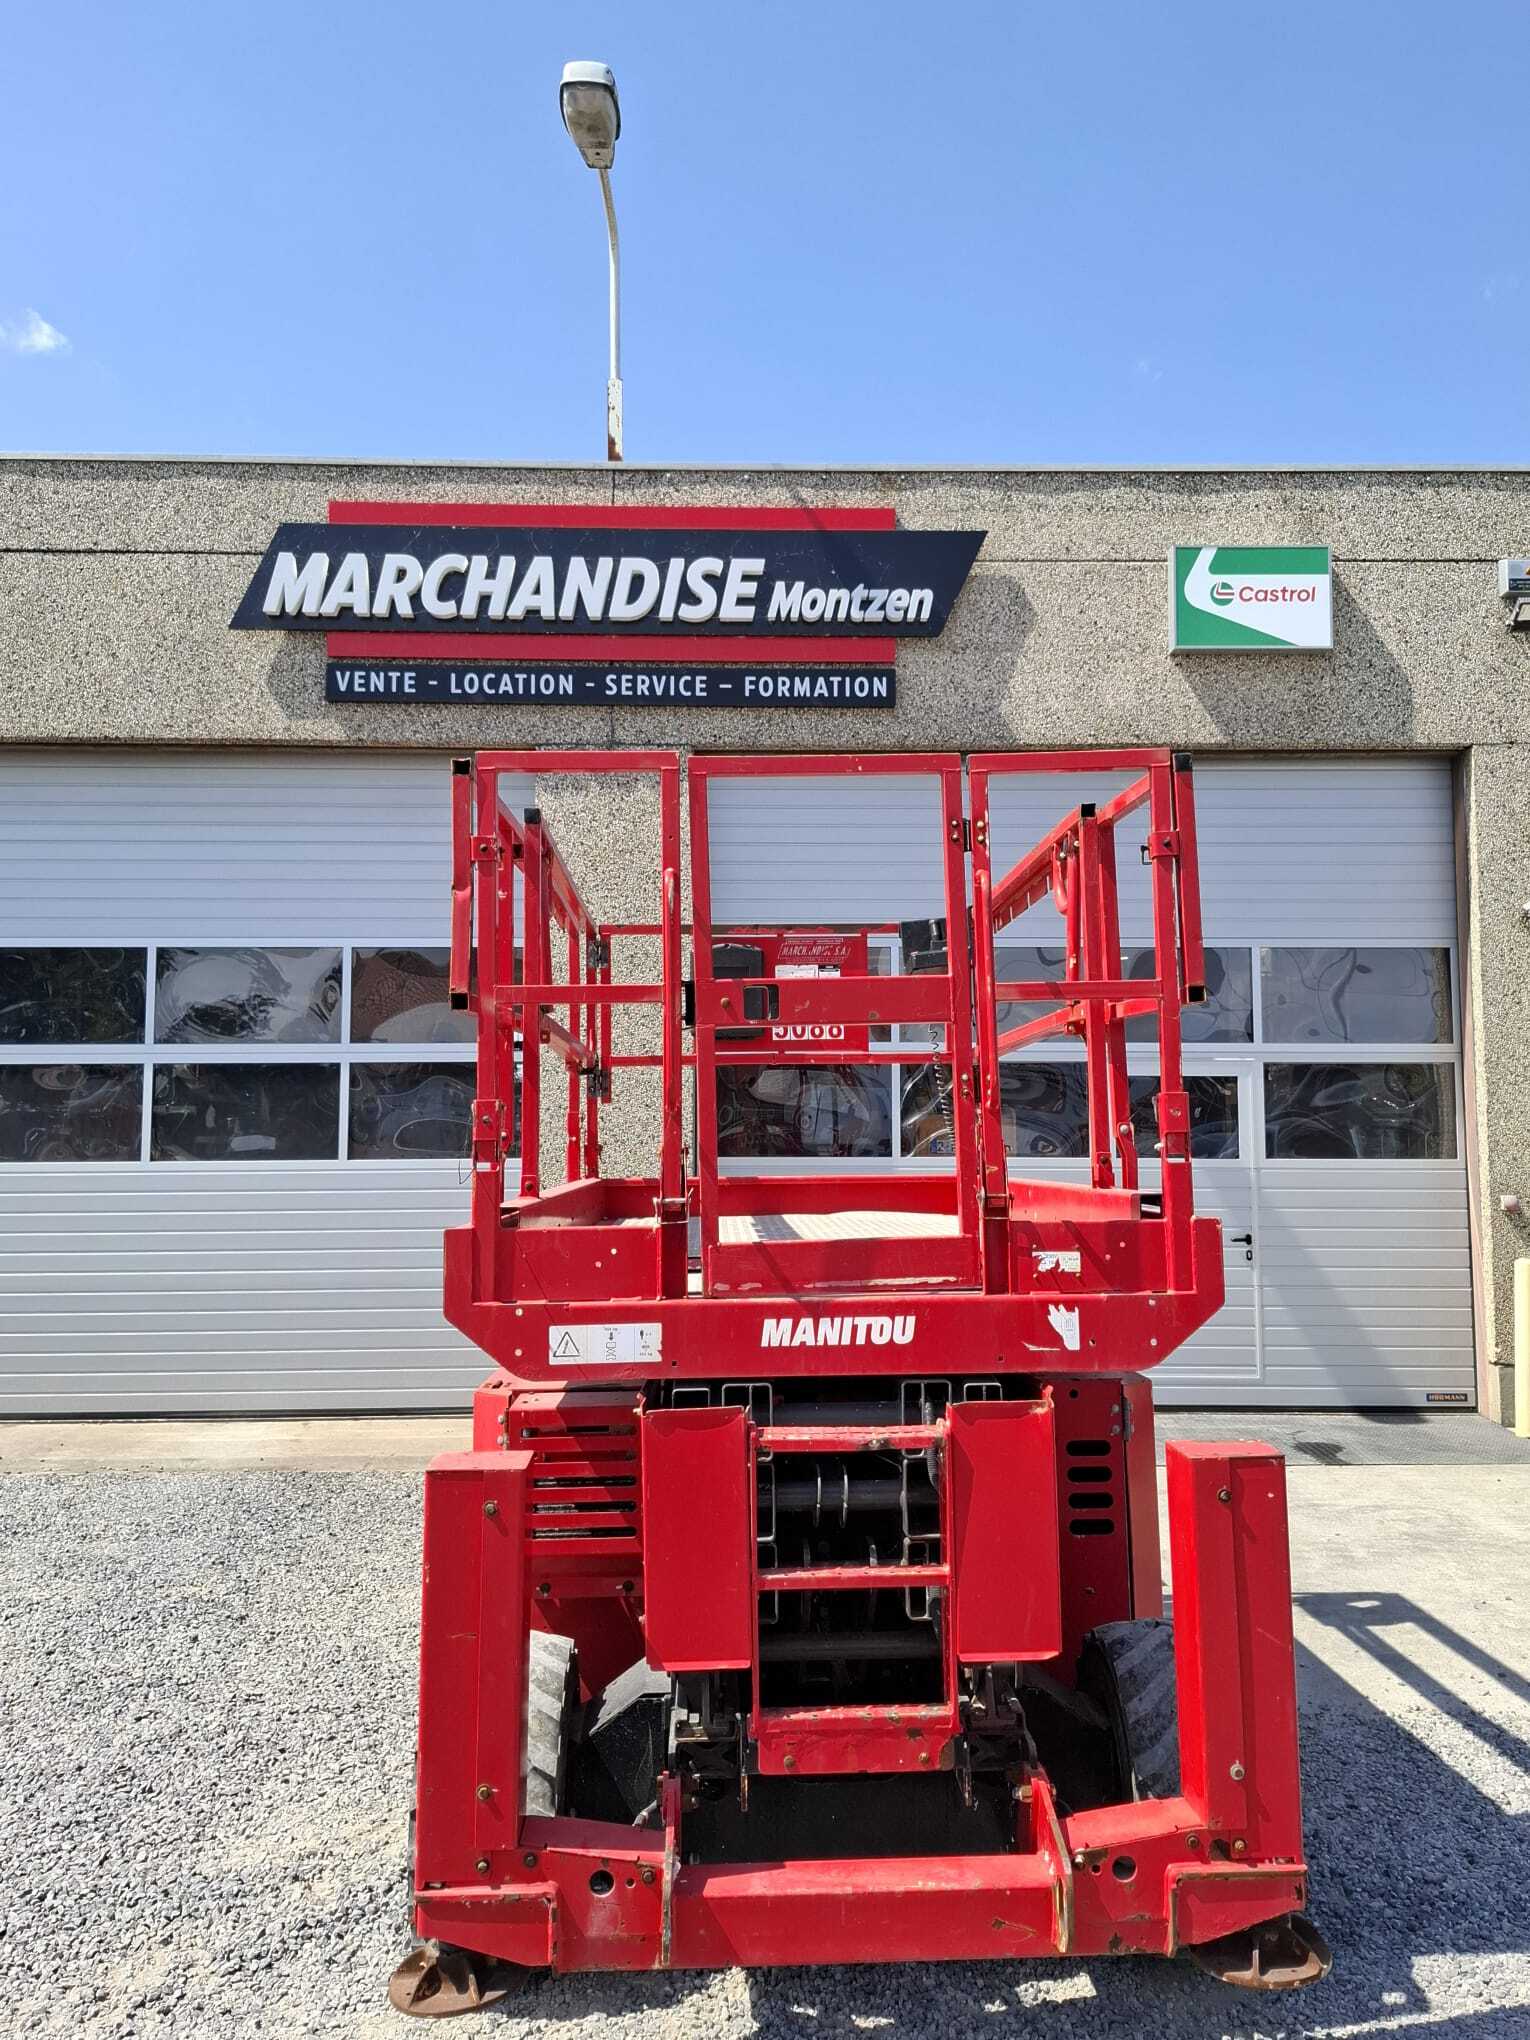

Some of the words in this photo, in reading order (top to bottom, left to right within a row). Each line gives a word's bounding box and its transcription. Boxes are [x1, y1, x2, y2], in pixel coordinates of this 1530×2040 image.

[262, 552, 766, 624] MARCHANDISE
[767, 580, 934, 624] Montzen
[1239, 586, 1316, 602] Castrol
[336, 671, 416, 693] VENTE
[450, 672, 575, 695] LOCATION
[605, 674, 708, 697] SERVICE
[743, 676, 888, 698] FORMATION
[761, 1315, 916, 1347] MANITOU
